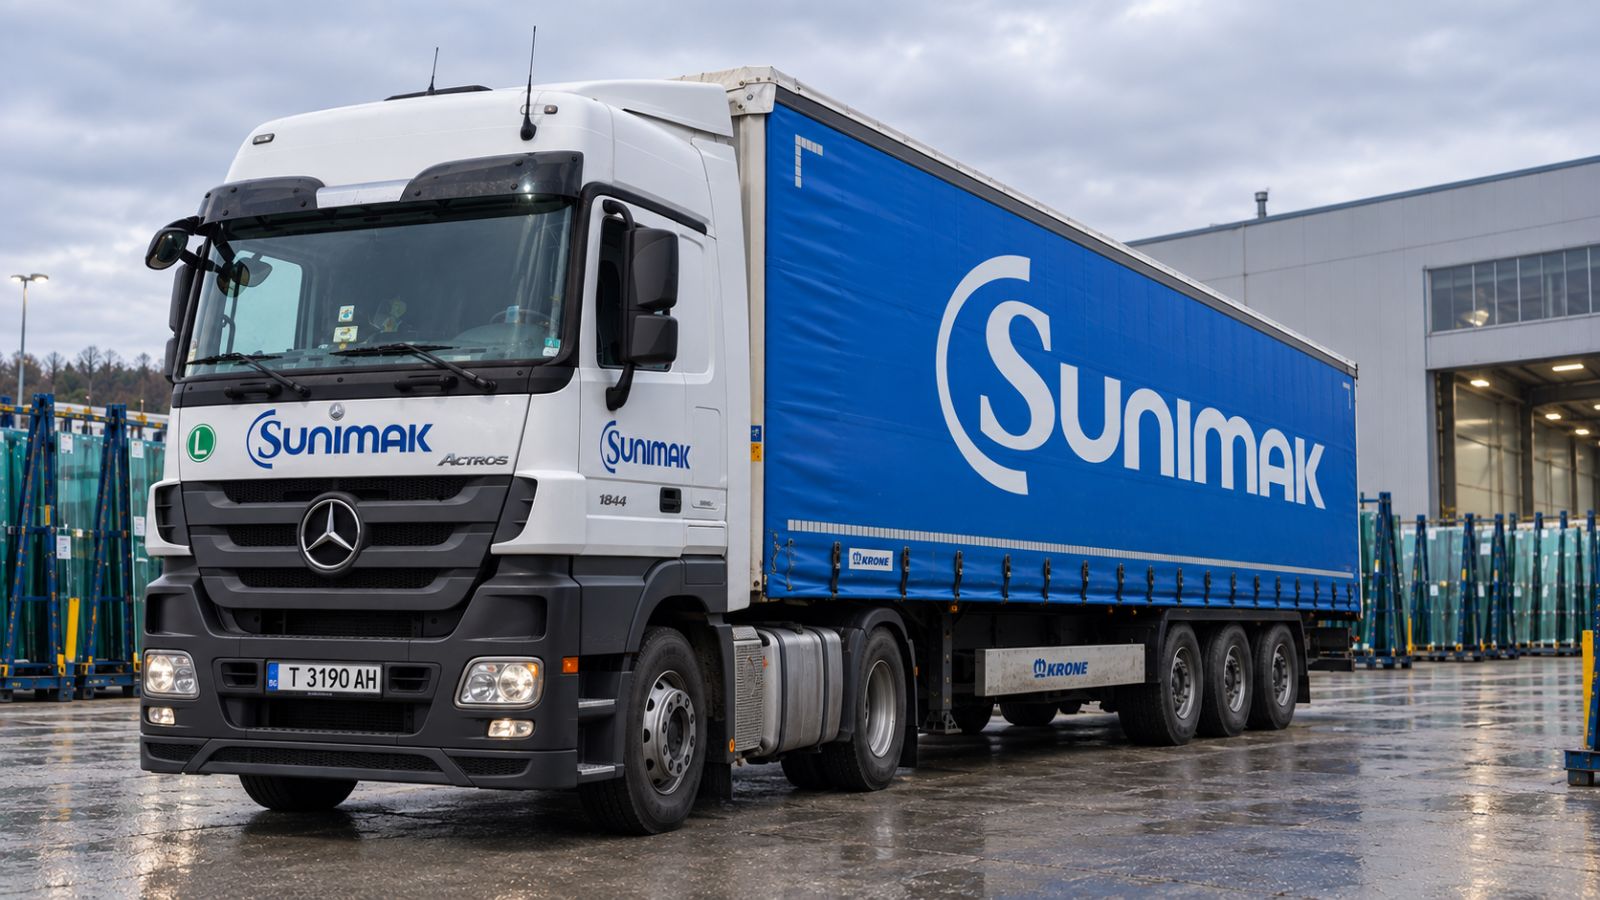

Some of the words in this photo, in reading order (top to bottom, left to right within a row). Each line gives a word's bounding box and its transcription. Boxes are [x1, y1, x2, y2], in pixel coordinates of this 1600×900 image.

[194, 430, 208, 456] L
[599, 493, 627, 507] 1844
[861, 556, 890, 567] KRONE
[1047, 661, 1089, 677] KRONE
[289, 667, 300, 687] T
[306, 667, 350, 689] 3190
[353, 669, 377, 690] AH
